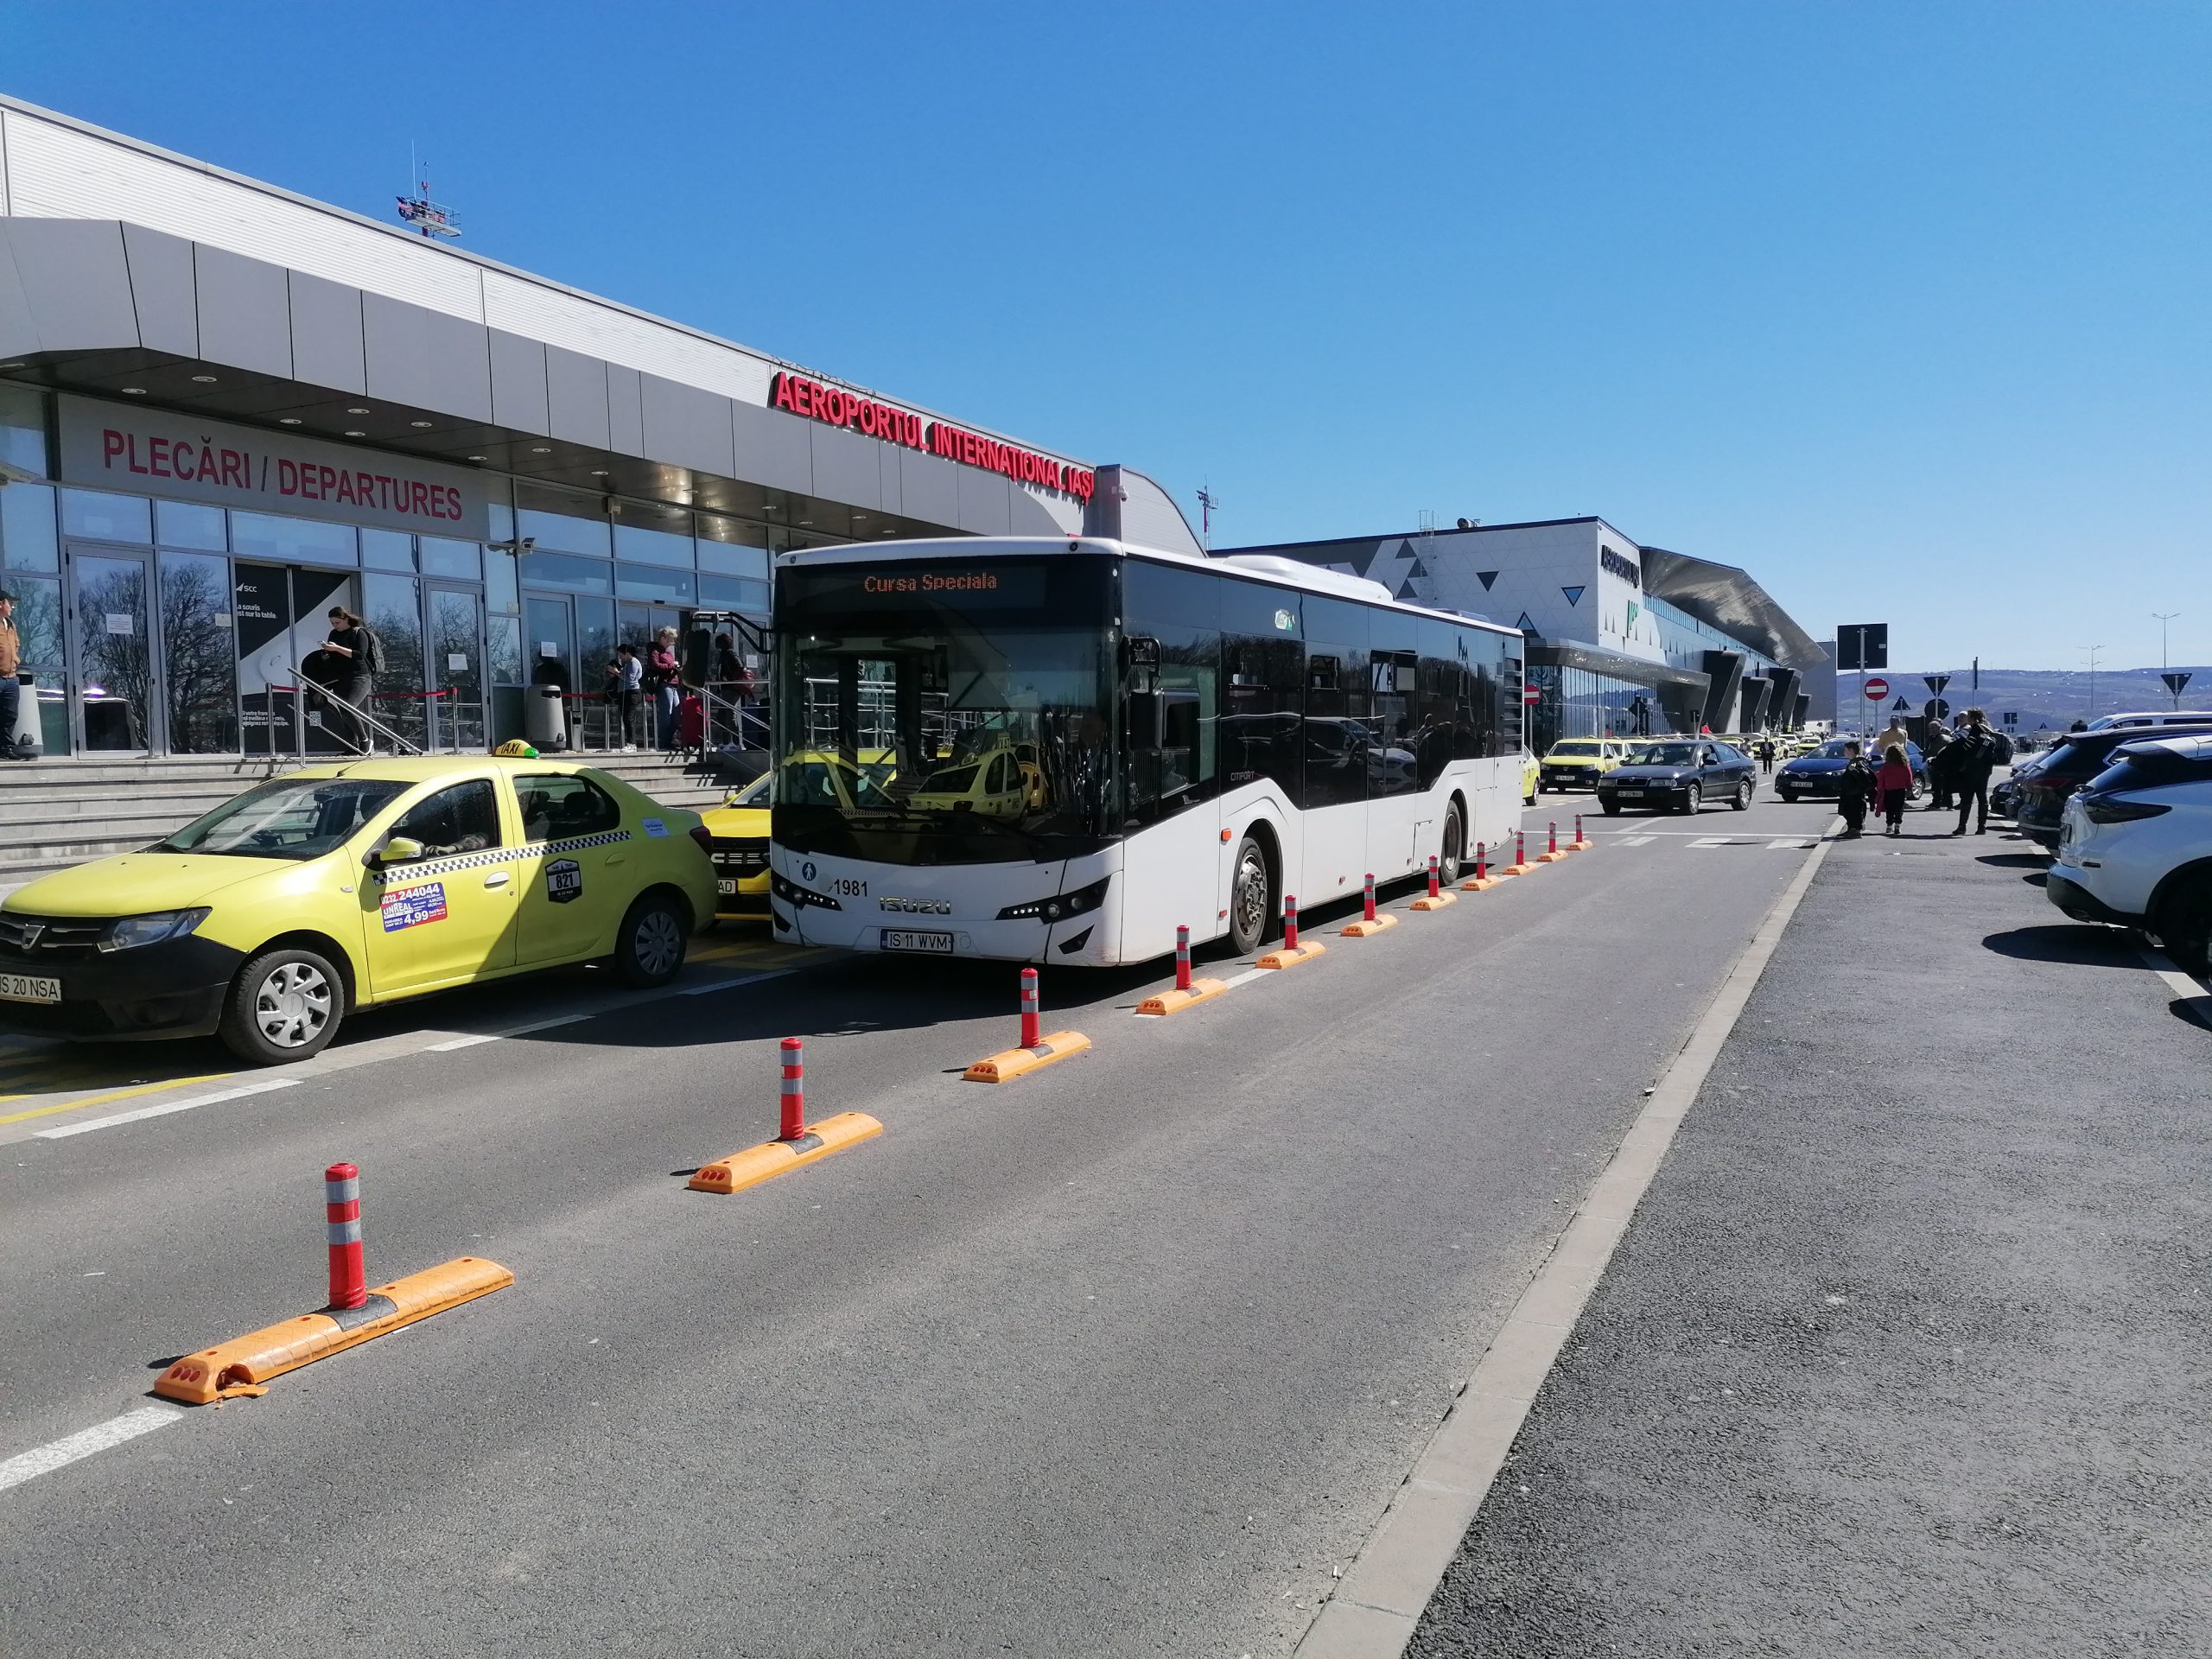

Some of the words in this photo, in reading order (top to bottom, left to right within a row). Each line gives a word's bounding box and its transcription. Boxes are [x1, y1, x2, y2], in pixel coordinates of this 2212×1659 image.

[776, 372, 930, 451] AEROPORTUL
[931, 422, 1065, 491] INTERNAȚIONAL
[1066, 466, 1095, 506] IAȘI
[103, 429, 251, 490] PLECĂRI
[277, 458, 462, 521] DEPARTURES
[864, 575, 917, 593] Cursa
[922, 571, 997, 591] Speciala
[501, 742, 521, 754] TAXI
[556, 873, 574, 889] 821
[834, 878, 868, 897] 1981
[383, 901, 413, 915] UNREAL
[880, 896, 951, 915] ISUZU
[404, 910, 429, 925] 4,99
[890, 933, 901, 947] IS
[905, 934, 913, 948] 11
[918, 935, 947, 950] WVM
[13, 977, 27, 995] 20
[29, 978, 59, 999] NSA
